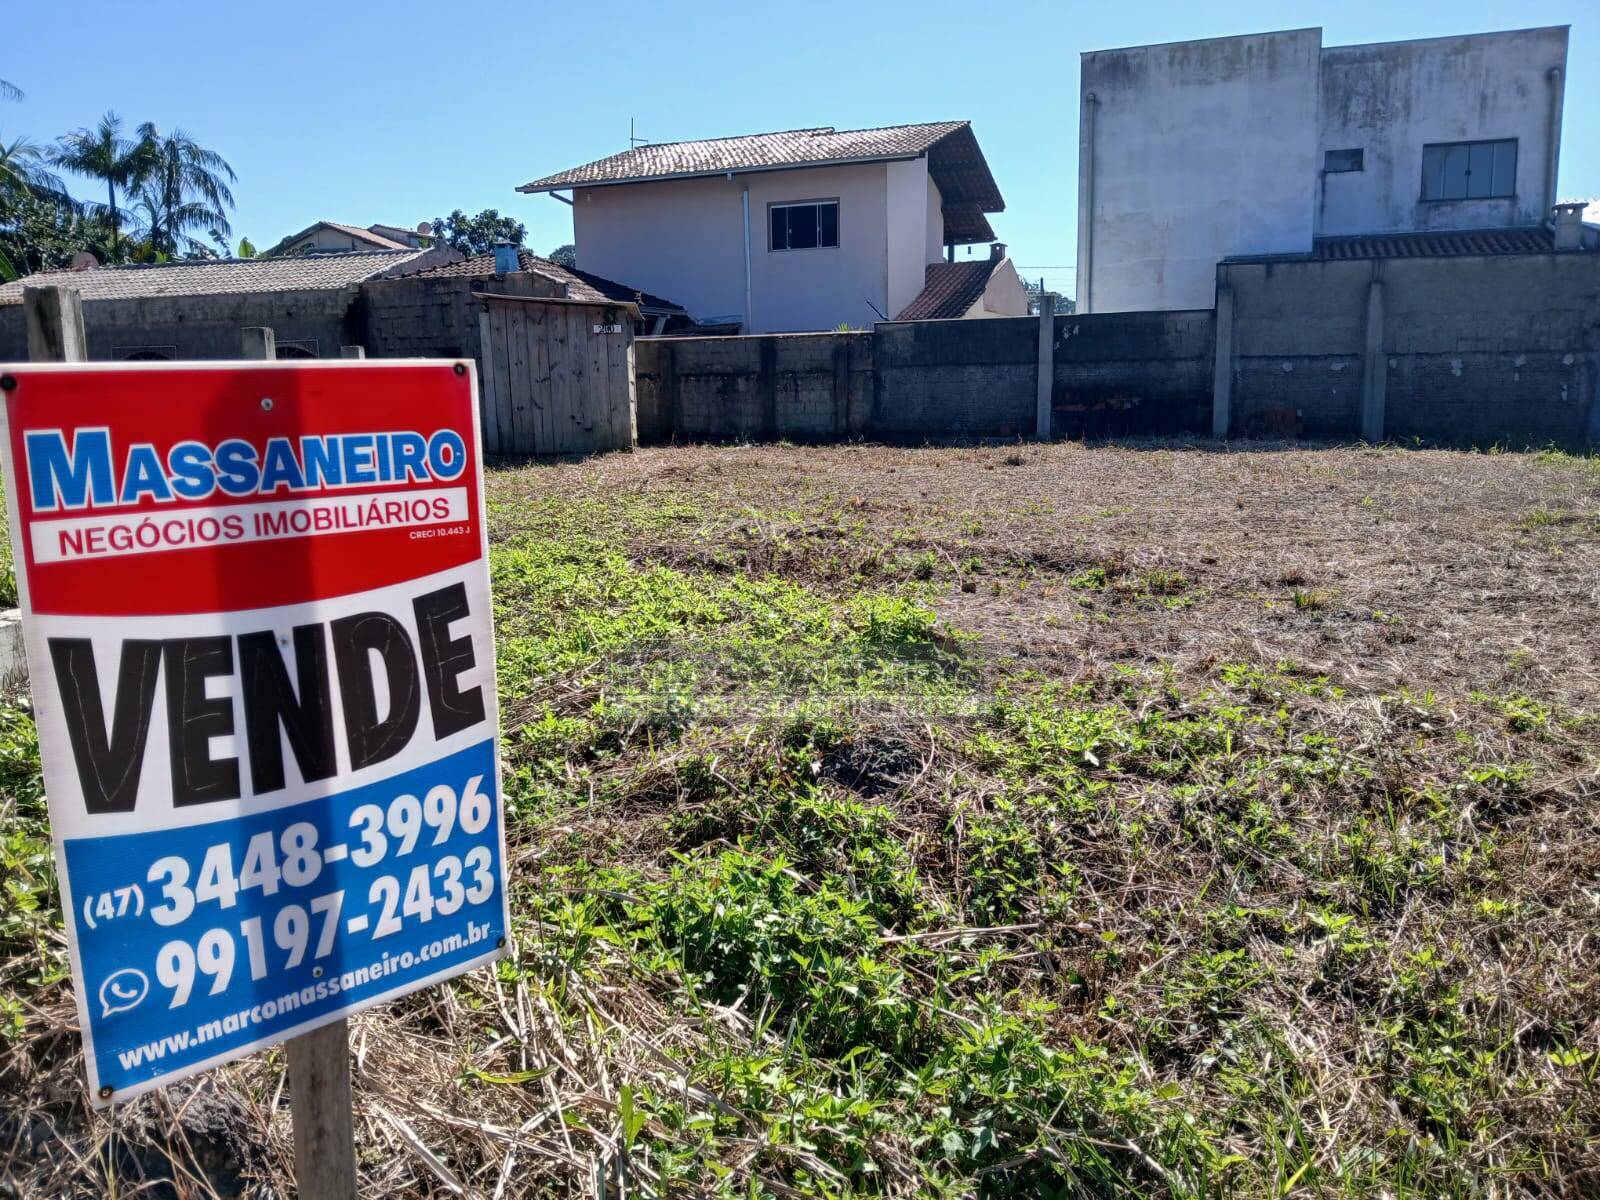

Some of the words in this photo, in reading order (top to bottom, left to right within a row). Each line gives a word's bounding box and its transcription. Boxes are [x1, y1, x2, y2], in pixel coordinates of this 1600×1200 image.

[24, 426, 467, 513] MASSANEIRO
[58, 515, 244, 557] NEGÓCIOS
[255, 497, 450, 538] IMOBILIÁRIOS
[409, 529, 436, 539] CRECI
[437, 526, 464, 537] 10.443
[465, 525, 471, 534] J
[47, 581, 486, 815] VENDE
[83, 884, 144, 929] (47)
[147, 774, 492, 926] 3448-3996
[118, 921, 491, 1071] www.marcomassaneiro.com.br
[155, 846, 495, 1010] 99197-2433
